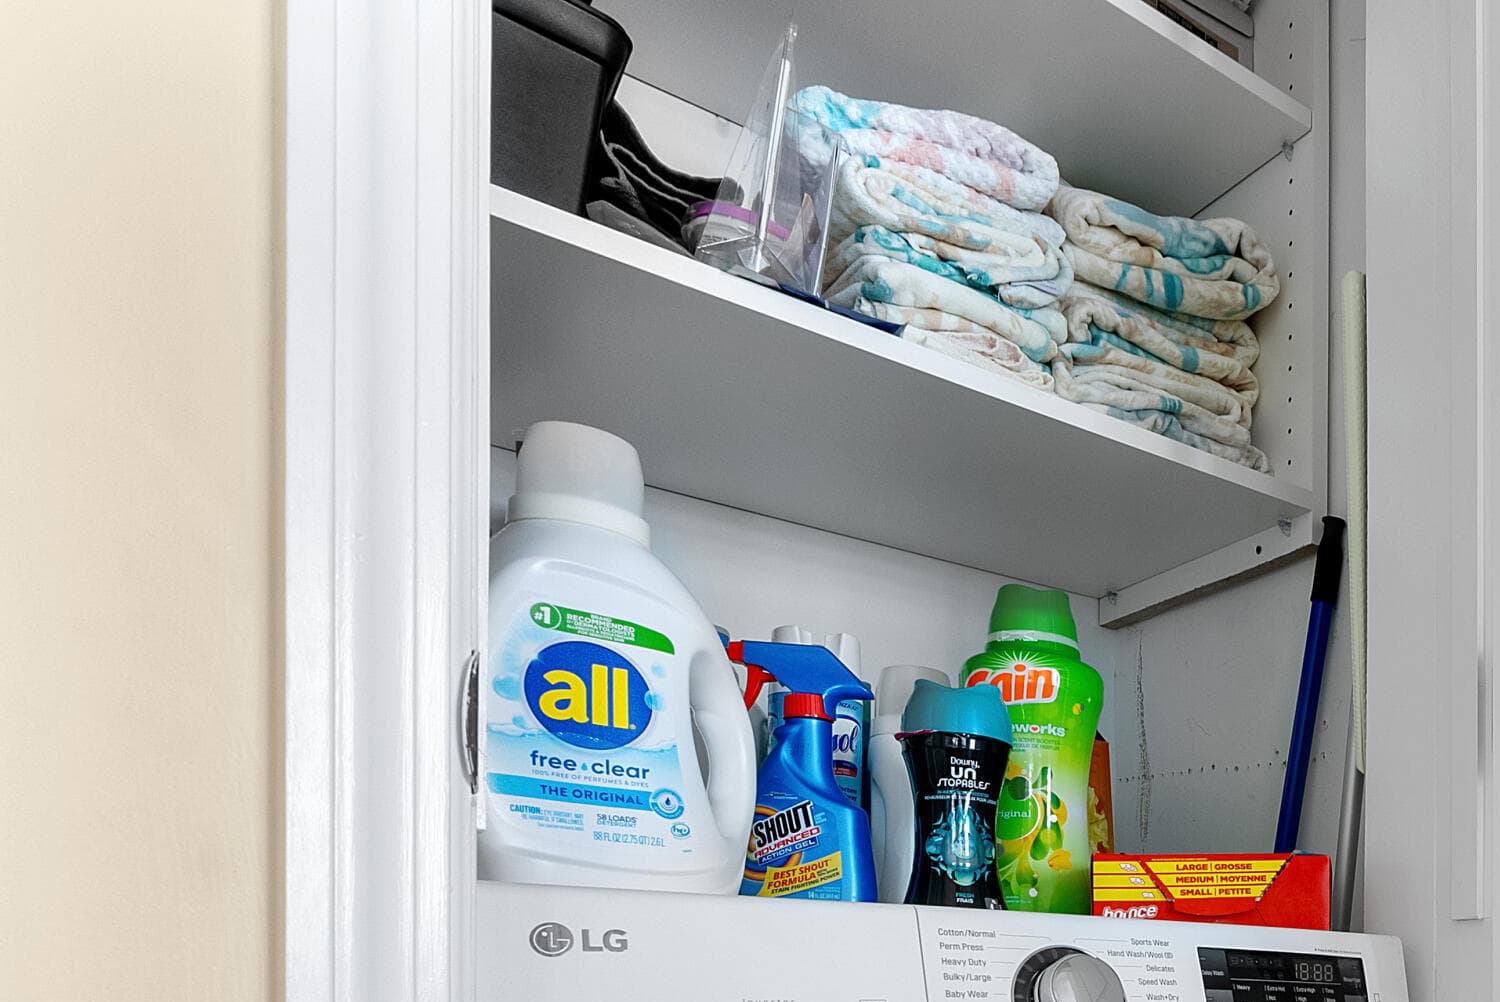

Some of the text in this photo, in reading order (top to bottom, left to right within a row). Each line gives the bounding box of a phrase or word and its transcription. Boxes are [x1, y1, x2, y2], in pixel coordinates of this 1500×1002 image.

[534, 606, 551, 624] #1
[566, 613, 635, 632] RECOMMENDED
[539, 663, 629, 729] all
[1012, 723, 1066, 737] works
[530, 750, 650, 779] free clear
[951, 756, 978, 768] Downy
[584, 775, 622, 785] PERFUMES
[937, 778, 991, 790] STOPABLES
[540, 784, 643, 805] THE ORIGINAL
[597, 819, 636, 828] DETERGENT
[754, 800, 811, 848] SHOUT
[754, 826, 820, 858] ADVANCED
[762, 839, 815, 862] ACTION GEL
[773, 868, 797, 880] BEST
[799, 859, 829, 874] SHOUT
[1175, 863, 1208, 871] LARGE
[767, 872, 816, 889] FORMULA
[771, 886, 790, 894] STAIN
[790, 879, 819, 890] FIGHTING
[820, 871, 840, 881] POWER
[1175, 875, 1214, 883] MEDIUM
[1180, 888, 1212, 896] SMALL
[937, 928, 996, 938] Cotton/Normal
[581, 929, 628, 952] LG
[939, 942, 984, 951] Perm Press
[1130, 938, 1152, 946] Sports
[1126, 950, 1163, 958] Wash/Wool
[941, 958, 987, 967] Heavy Duty
[1146, 964, 1175, 972] Delicates
[943, 973, 992, 982] Bulky/Large
[1295, 962, 1333, 982] 18:88
[1138, 977, 1177, 986] Speed Wash
[945, 990, 989, 999] Baby Wear
[1146, 993, 1180, 1002] Wash+Dry
